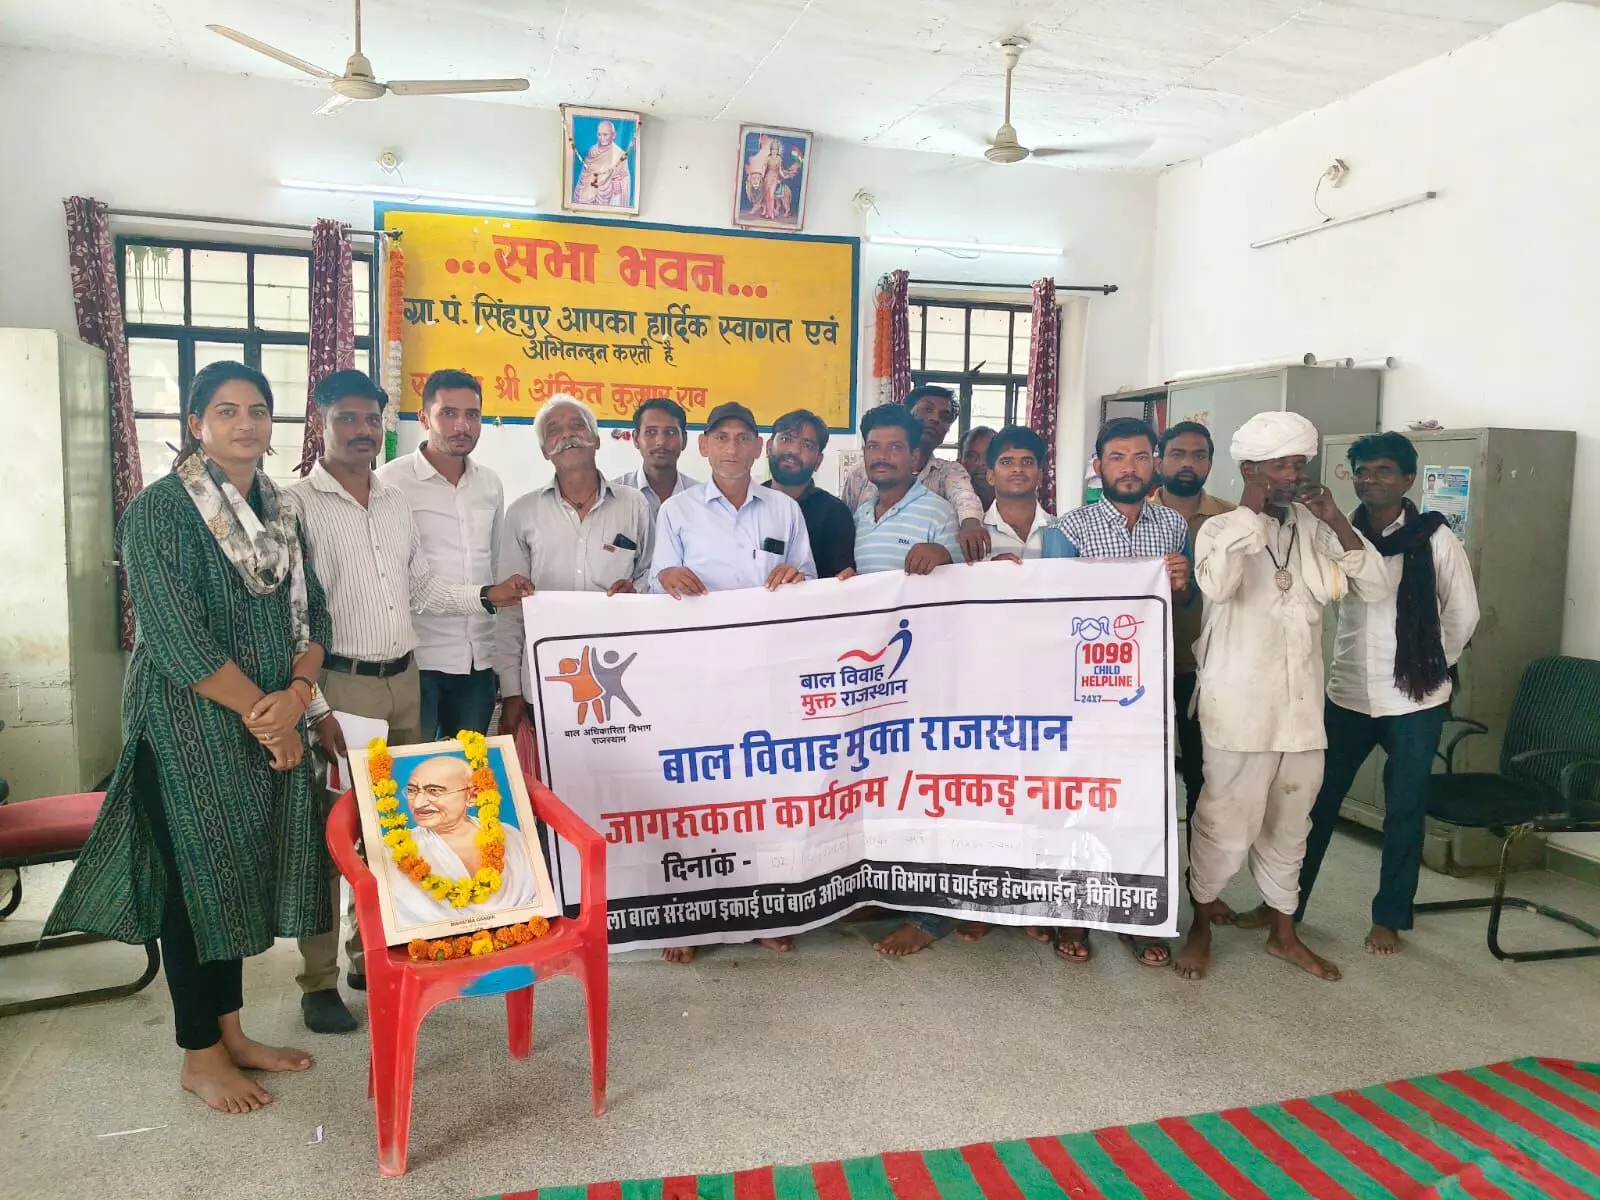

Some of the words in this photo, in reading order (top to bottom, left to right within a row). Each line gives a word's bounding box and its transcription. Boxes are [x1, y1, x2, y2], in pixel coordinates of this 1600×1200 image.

[472, 292, 554, 339] सिंहपुर
[557, 306, 637, 336] आपका
[644, 303, 708, 345] हार्दिक
[718, 315, 792, 345] स्वागत
[803, 314, 839, 345] एवं
[523, 335, 609, 364] अभिनन्दन
[612, 340, 652, 365] करती
[663, 340, 677, 366] है
[495, 364, 521, 402] श्री
[528, 371, 605, 405] अंकित
[676, 387, 708, 412] राव
[1082, 642, 1133, 664] 1098
[799, 672, 836, 689] बाल
[840, 665, 885, 686] विवाह
[1081, 676, 1133, 687] HELPLINE
[1094, 665, 1120, 675] CHILD
[800, 693, 837, 716] मुक्त
[840, 680, 908, 706] राजस्थान
[584, 726, 625, 736] अधिकारिता
[629, 724, 652, 734] विभाग
[592, 736, 626, 744] राजस्थान
[658, 743, 734, 784] बाल
[740, 729, 841, 778] विवाह
[845, 718, 914, 773] मुक्त
[919, 714, 1073, 752] राजस्थान
[772, 776, 889, 829] कार्यक्रम
[1024, 775, 1122, 812] नाटक
[661, 848, 736, 882] दिनांक
[606, 909, 627, 930] ला
[628, 905, 661, 927] बाल
[662, 897, 717, 924] संरक्षण
[718, 889, 760, 920] इकाई
[762, 887, 785, 914] एवं
[786, 888, 816, 912] बाल
[818, 863, 889, 905] अधिकारिता
[891, 865, 936, 893] विभाग
[938, 873, 951, 893] व
[952, 868, 999, 899] चाईल्ड
